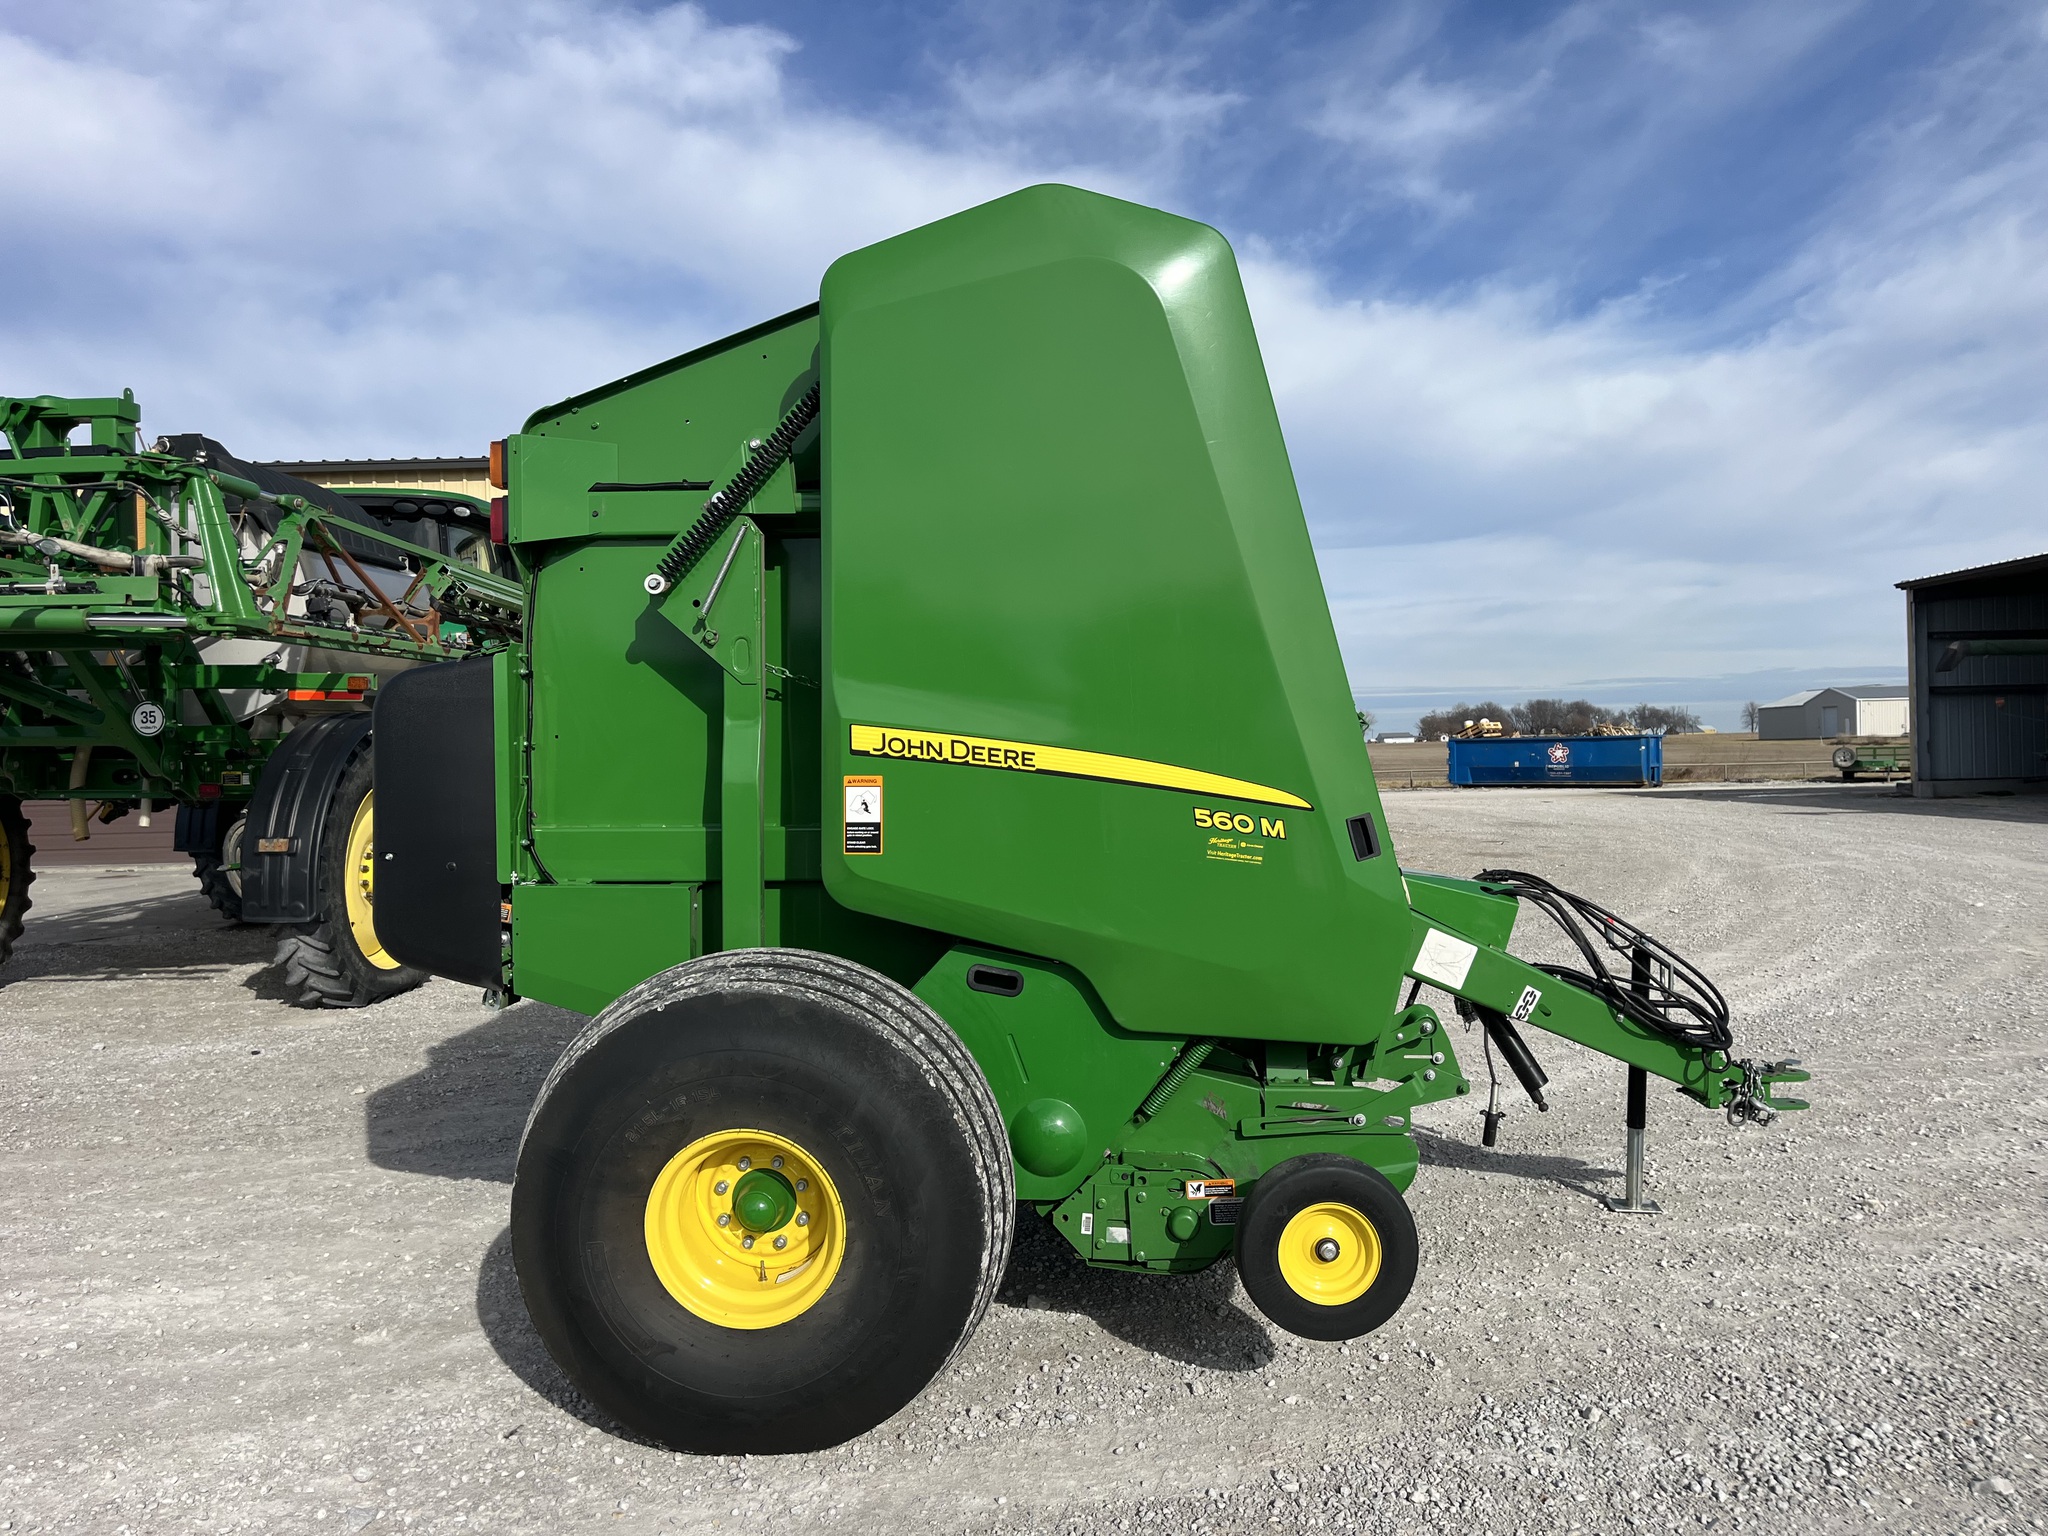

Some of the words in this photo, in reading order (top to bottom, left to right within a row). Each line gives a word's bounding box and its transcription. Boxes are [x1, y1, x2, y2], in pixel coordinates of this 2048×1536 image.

[140, 710, 156, 724] 35
[873, 732, 943, 758] JOHN
[950, 739, 1036, 768] DEERE
[1193, 807, 1255, 834] 560
[1259, 816, 1287, 840] M
